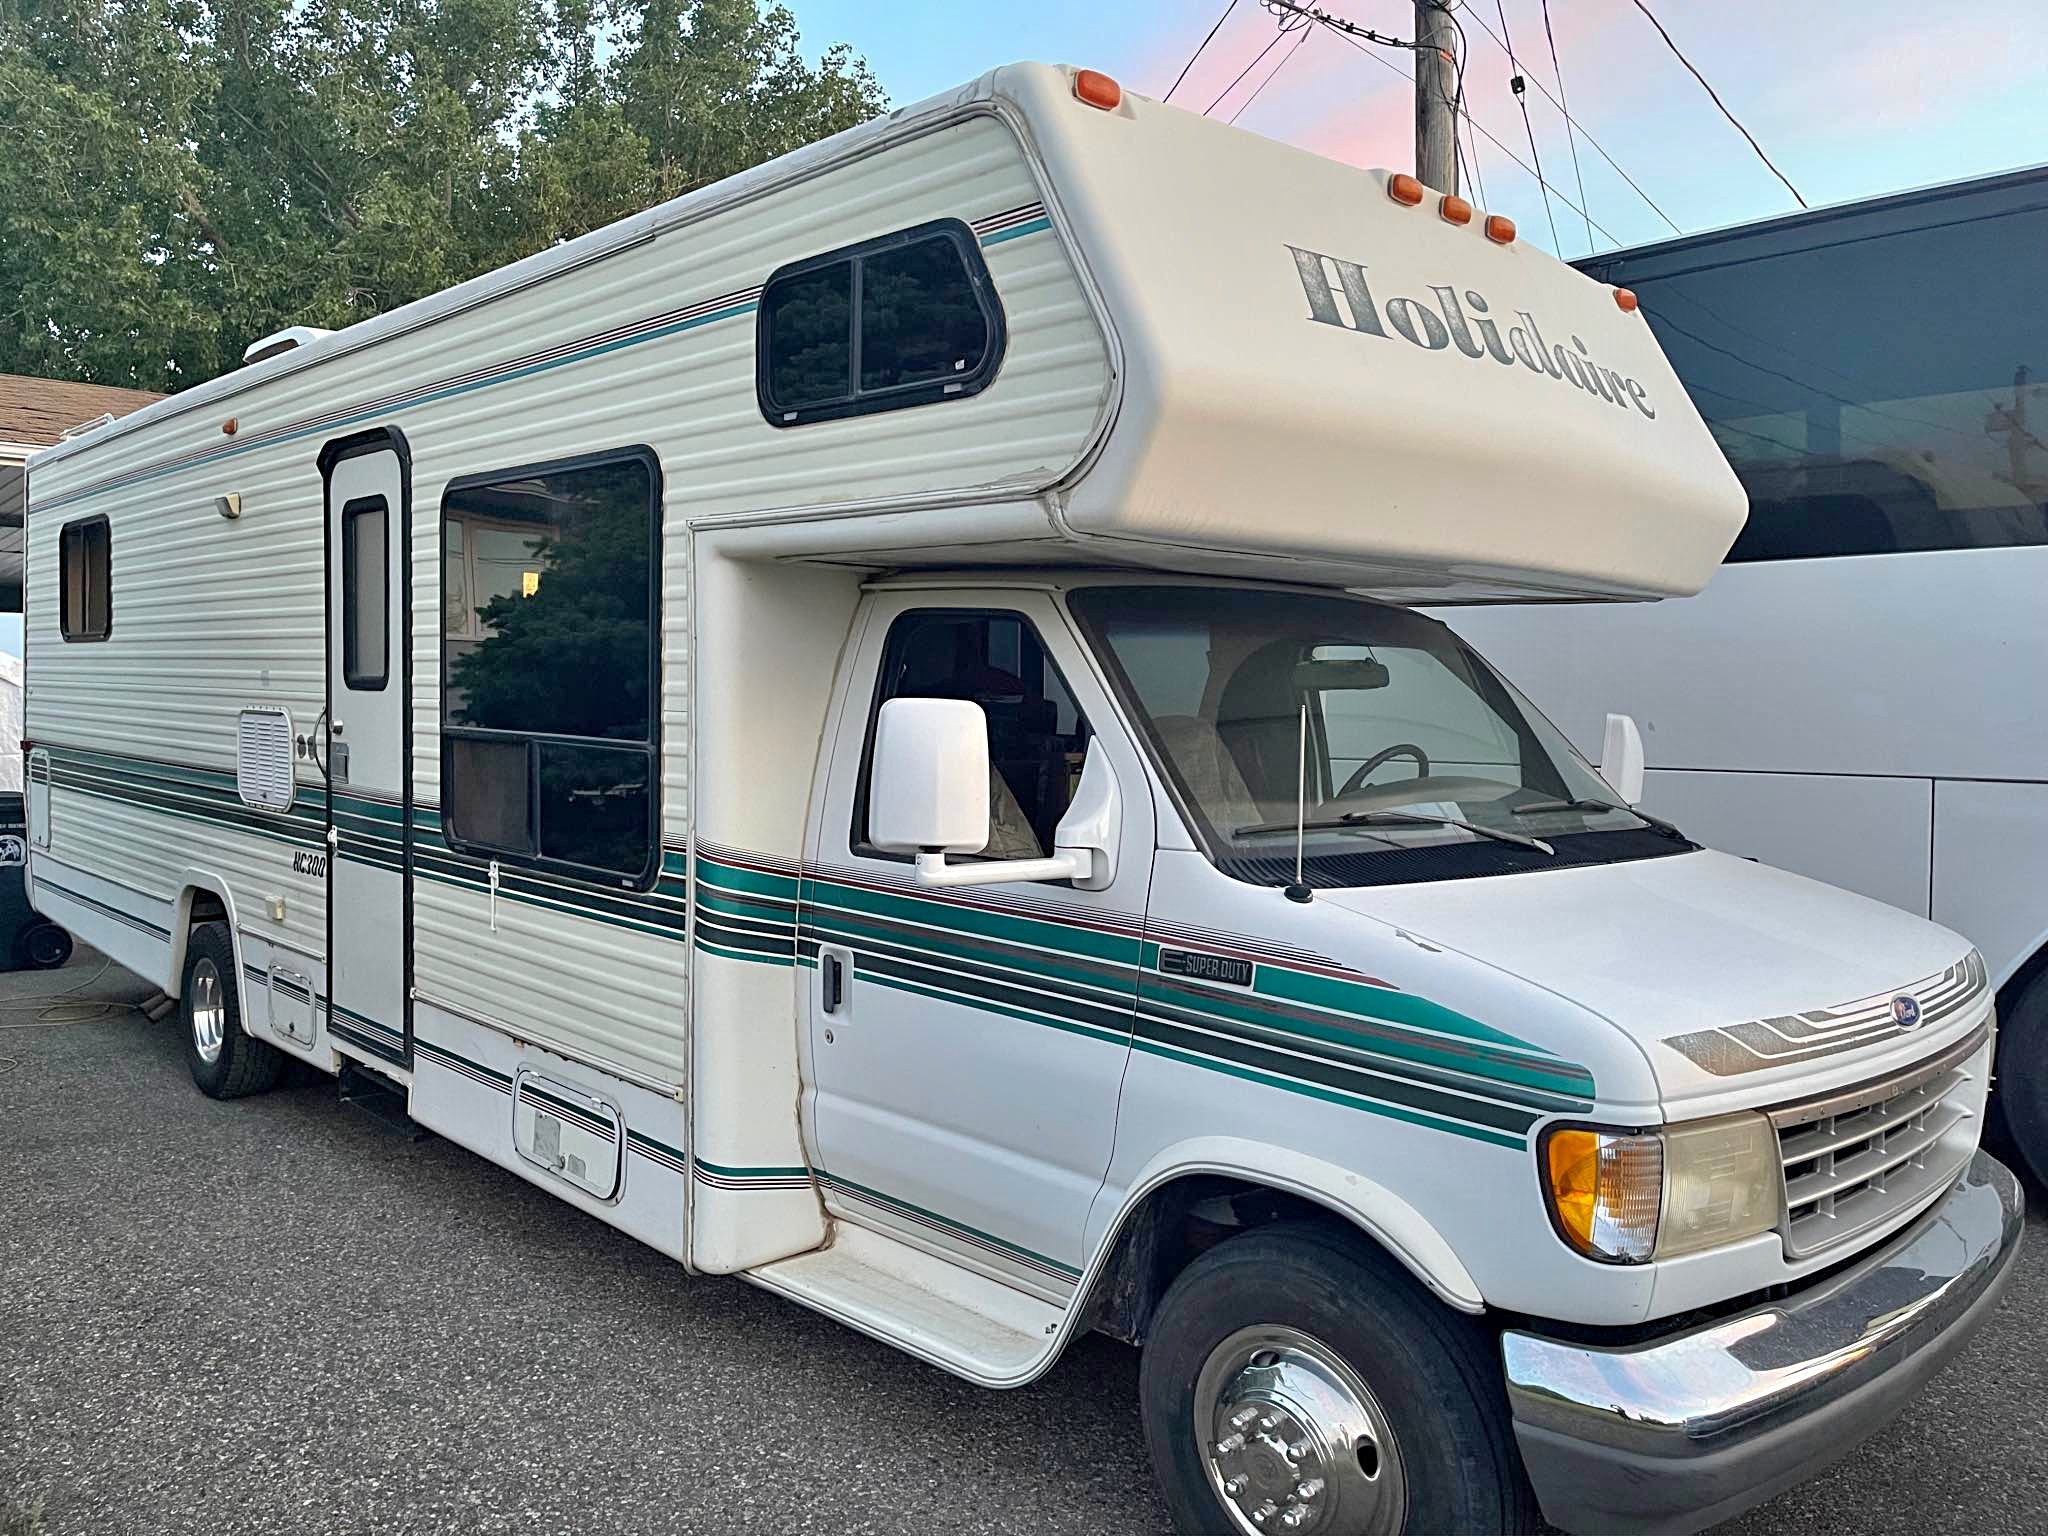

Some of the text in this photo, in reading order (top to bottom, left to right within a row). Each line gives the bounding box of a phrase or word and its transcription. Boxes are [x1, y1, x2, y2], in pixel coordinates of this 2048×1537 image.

[1283, 243, 1655, 420] Holidaire
[1186, 955, 1219, 977] SUPER
[1221, 960, 1250, 981] DUTY
